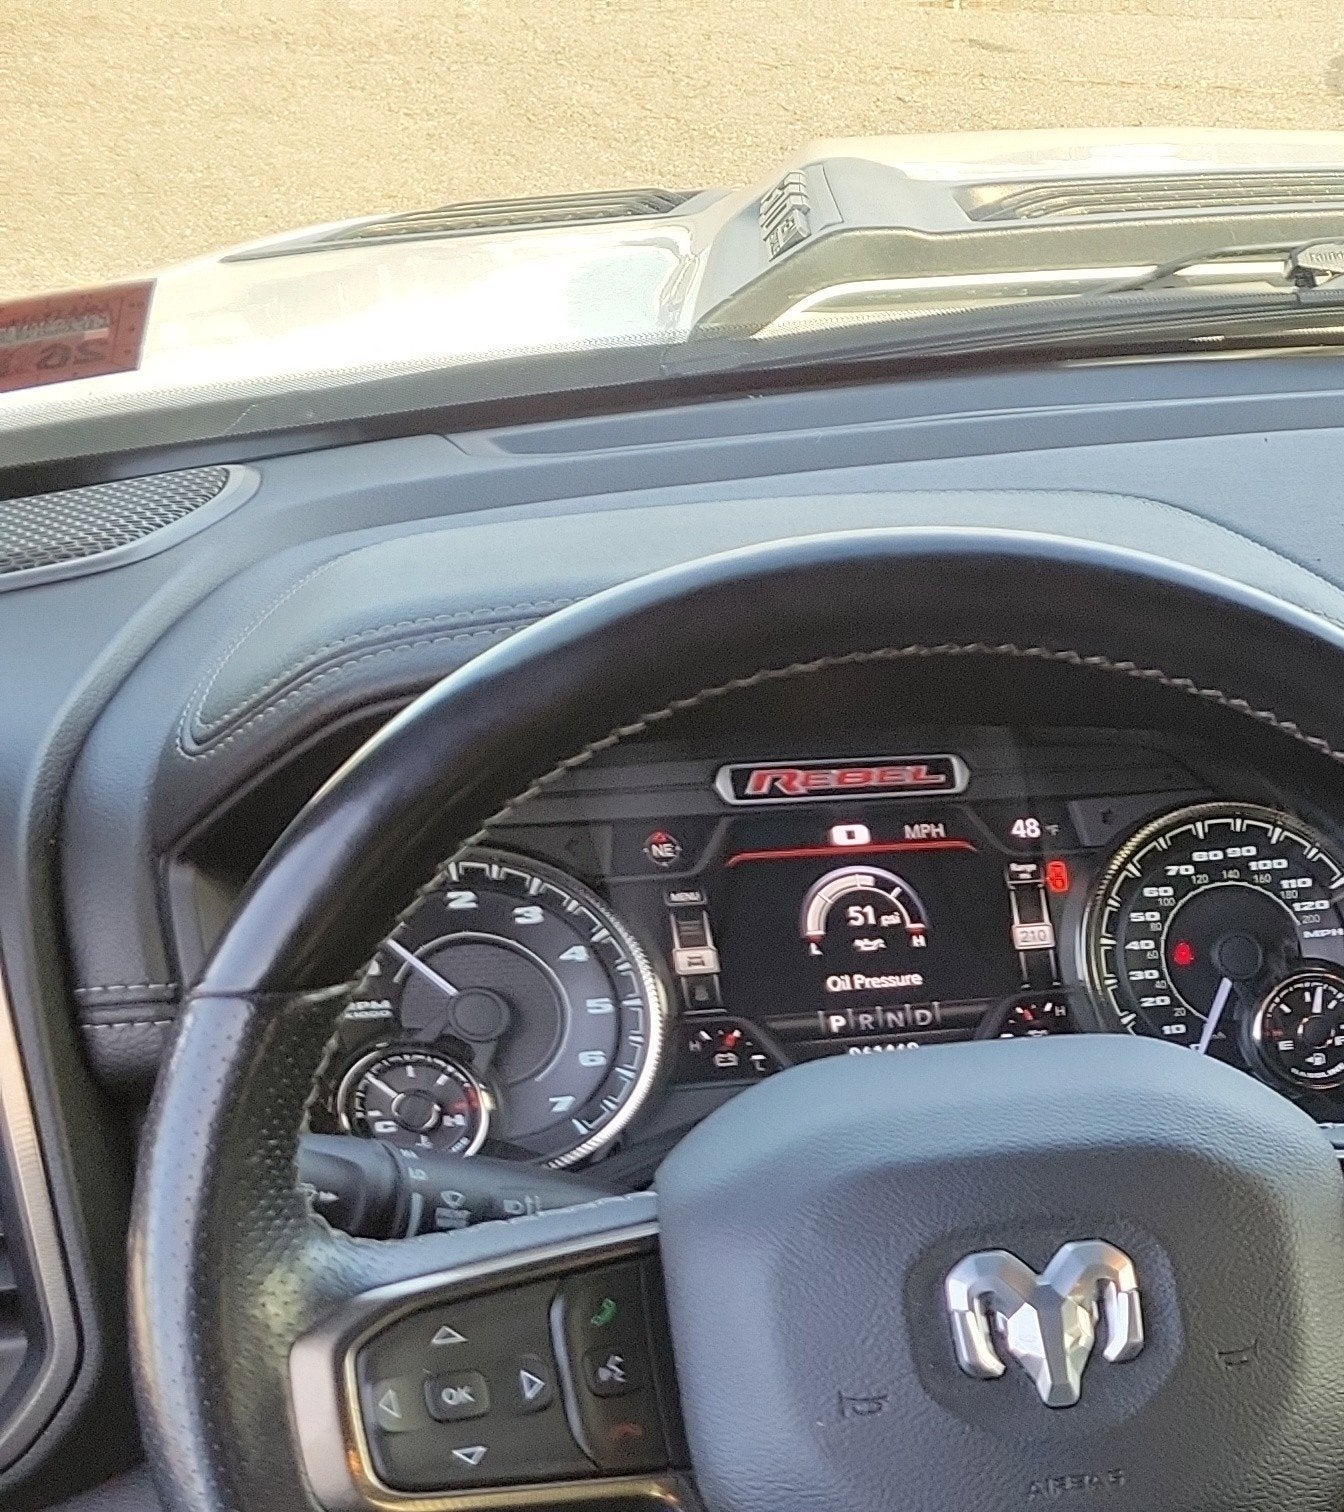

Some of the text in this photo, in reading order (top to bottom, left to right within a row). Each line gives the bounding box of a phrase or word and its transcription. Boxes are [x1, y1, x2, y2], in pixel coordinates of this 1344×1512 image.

[745, 764, 947, 797] REBEL
[903, 822, 945, 840] MPH
[1010, 817, 1042, 839] 48
[651, 844, 677, 859] NE
[1164, 865, 1196, 876] 70
[1248, 858, 1288, 871] 100
[1142, 886, 1175, 898] 60
[446, 891, 478, 909] 2
[1292, 900, 1331, 912] 120
[513, 905, 545, 924] 3
[847, 905, 876, 926] 51
[1129, 911, 1161, 922] 50
[1019, 929, 1048, 943] 210
[1302, 927, 1344, 939] MPH
[1124, 939, 1156, 950] 40
[559, 945, 590, 963] 4
[826, 971, 924, 993] Oil Pressure
[1128, 969, 1160, 981] 30
[586, 998, 614, 1015] 5
[1140, 995, 1171, 1008] 20
[828, 1007, 934, 1033] P R N D
[1162, 1023, 1187, 1035] 10
[1278, 1039, 1295, 1050] E
[578, 1050, 607, 1067] 6
[549, 1096, 576, 1112] 7
